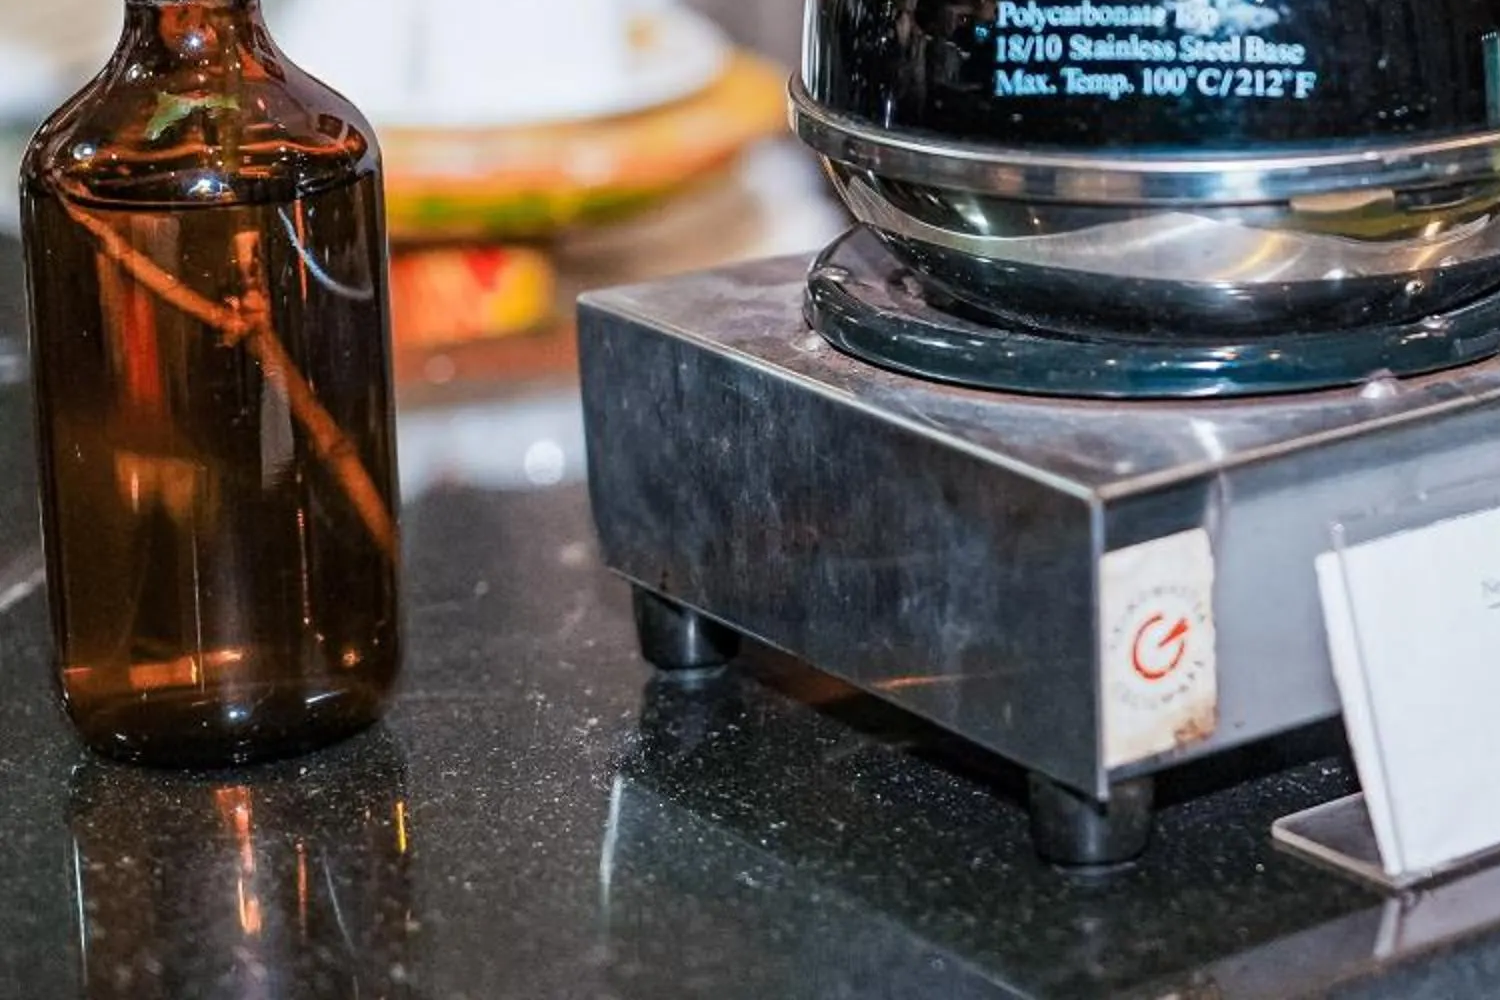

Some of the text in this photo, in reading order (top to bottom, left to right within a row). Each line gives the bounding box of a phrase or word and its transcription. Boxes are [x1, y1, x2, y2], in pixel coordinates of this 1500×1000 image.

[997, 0, 1166, 32] Polycarbonate
[995, 33, 1305, 65] 18/10 Stainless Steel Base
[995, 67, 1056, 98] Max.
[1060, 66, 1135, 101] Temp.
